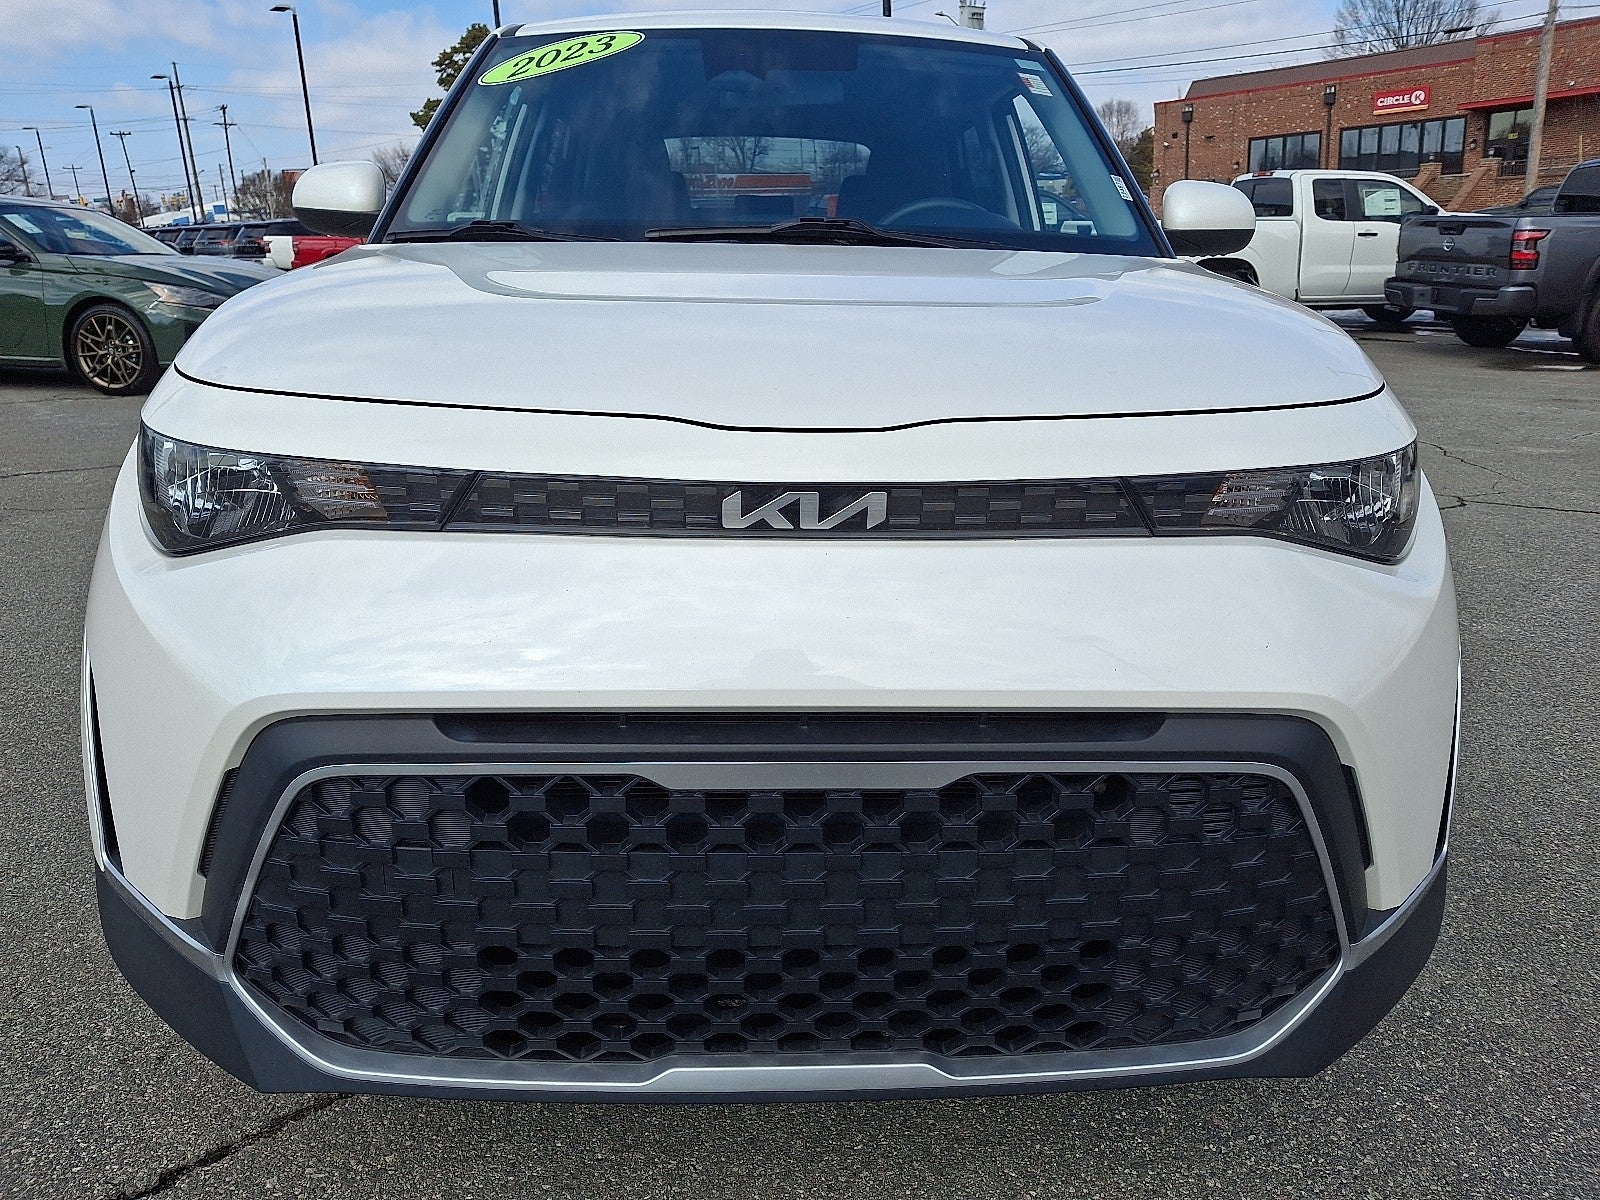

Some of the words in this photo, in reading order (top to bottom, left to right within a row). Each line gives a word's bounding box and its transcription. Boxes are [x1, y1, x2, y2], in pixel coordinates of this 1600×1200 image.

[507, 35, 616, 79] 2023
[1377, 95, 1410, 106] CIRCLE
[1412, 91, 1424, 104] K
[1407, 262, 1497, 278] FRONTIER
[722, 490, 887, 529] KIA
